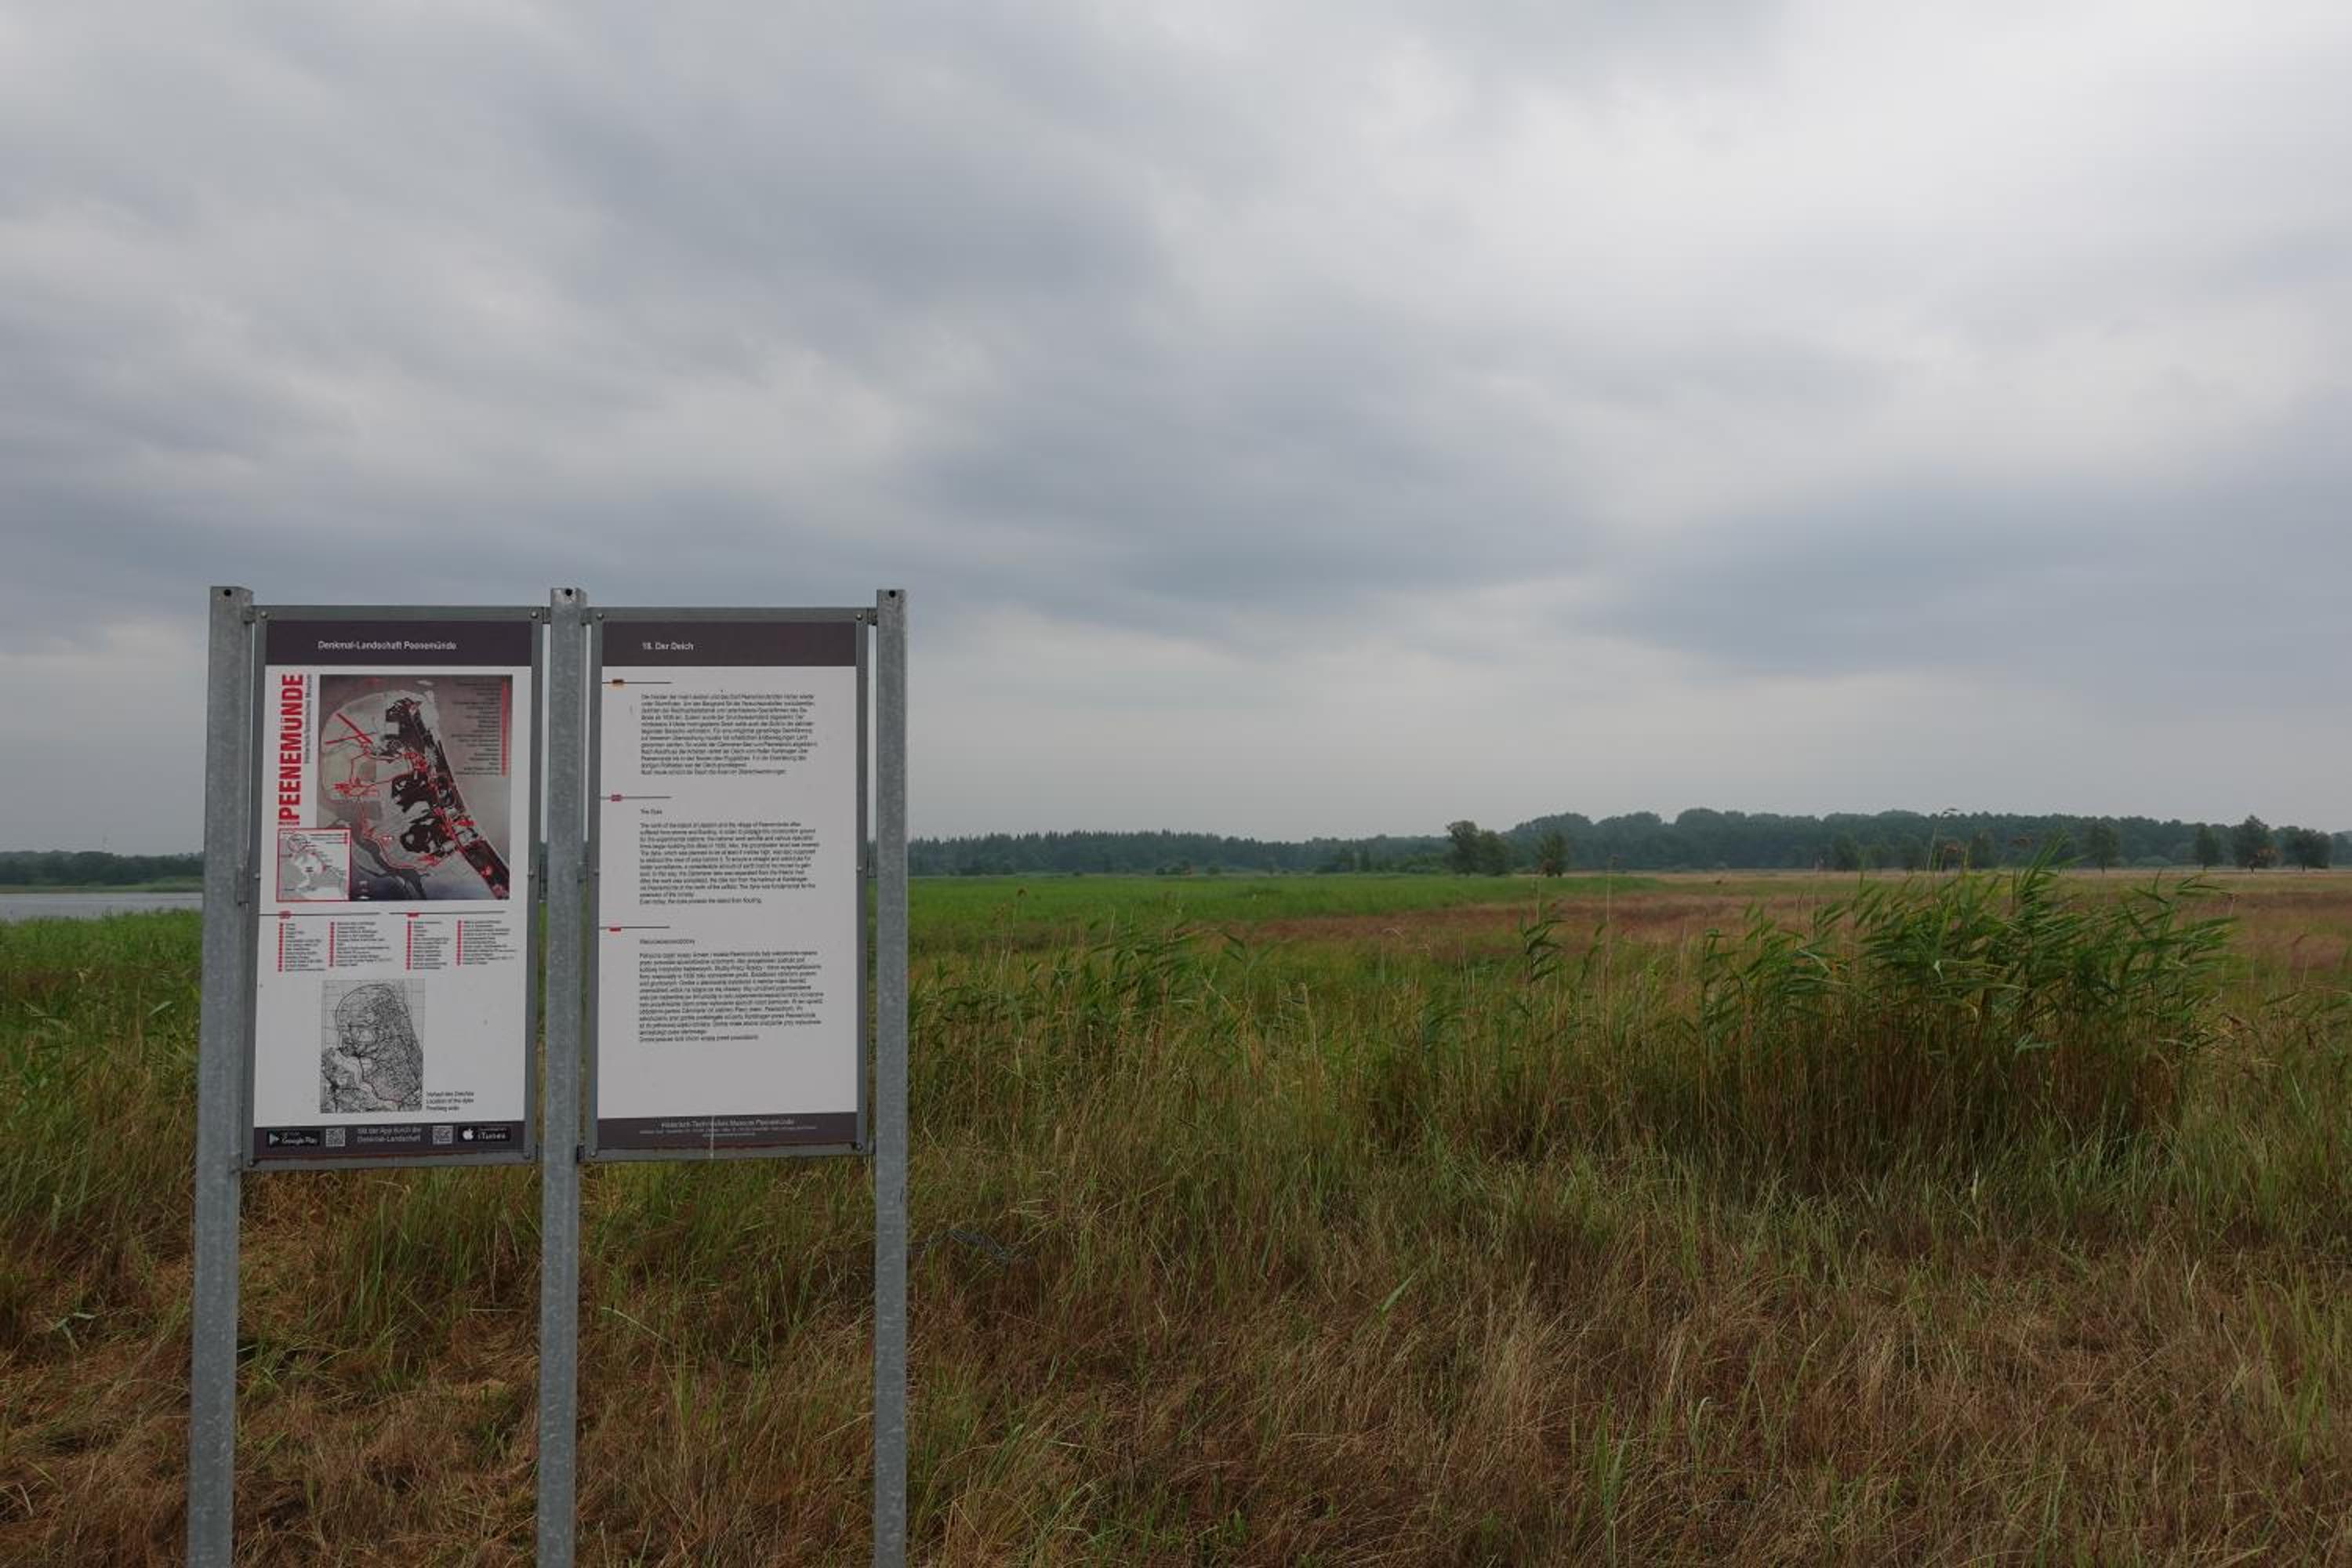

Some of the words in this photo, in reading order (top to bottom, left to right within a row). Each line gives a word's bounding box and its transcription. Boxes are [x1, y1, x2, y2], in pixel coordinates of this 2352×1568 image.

[318, 640, 401, 651] Denkmal-Landschaft
[404, 640, 456, 651] Peenemünde
[655, 641, 669, 650] Der
[670, 641, 694, 650] Deich
[278, 673, 303, 820] PEENEMÜNDE
